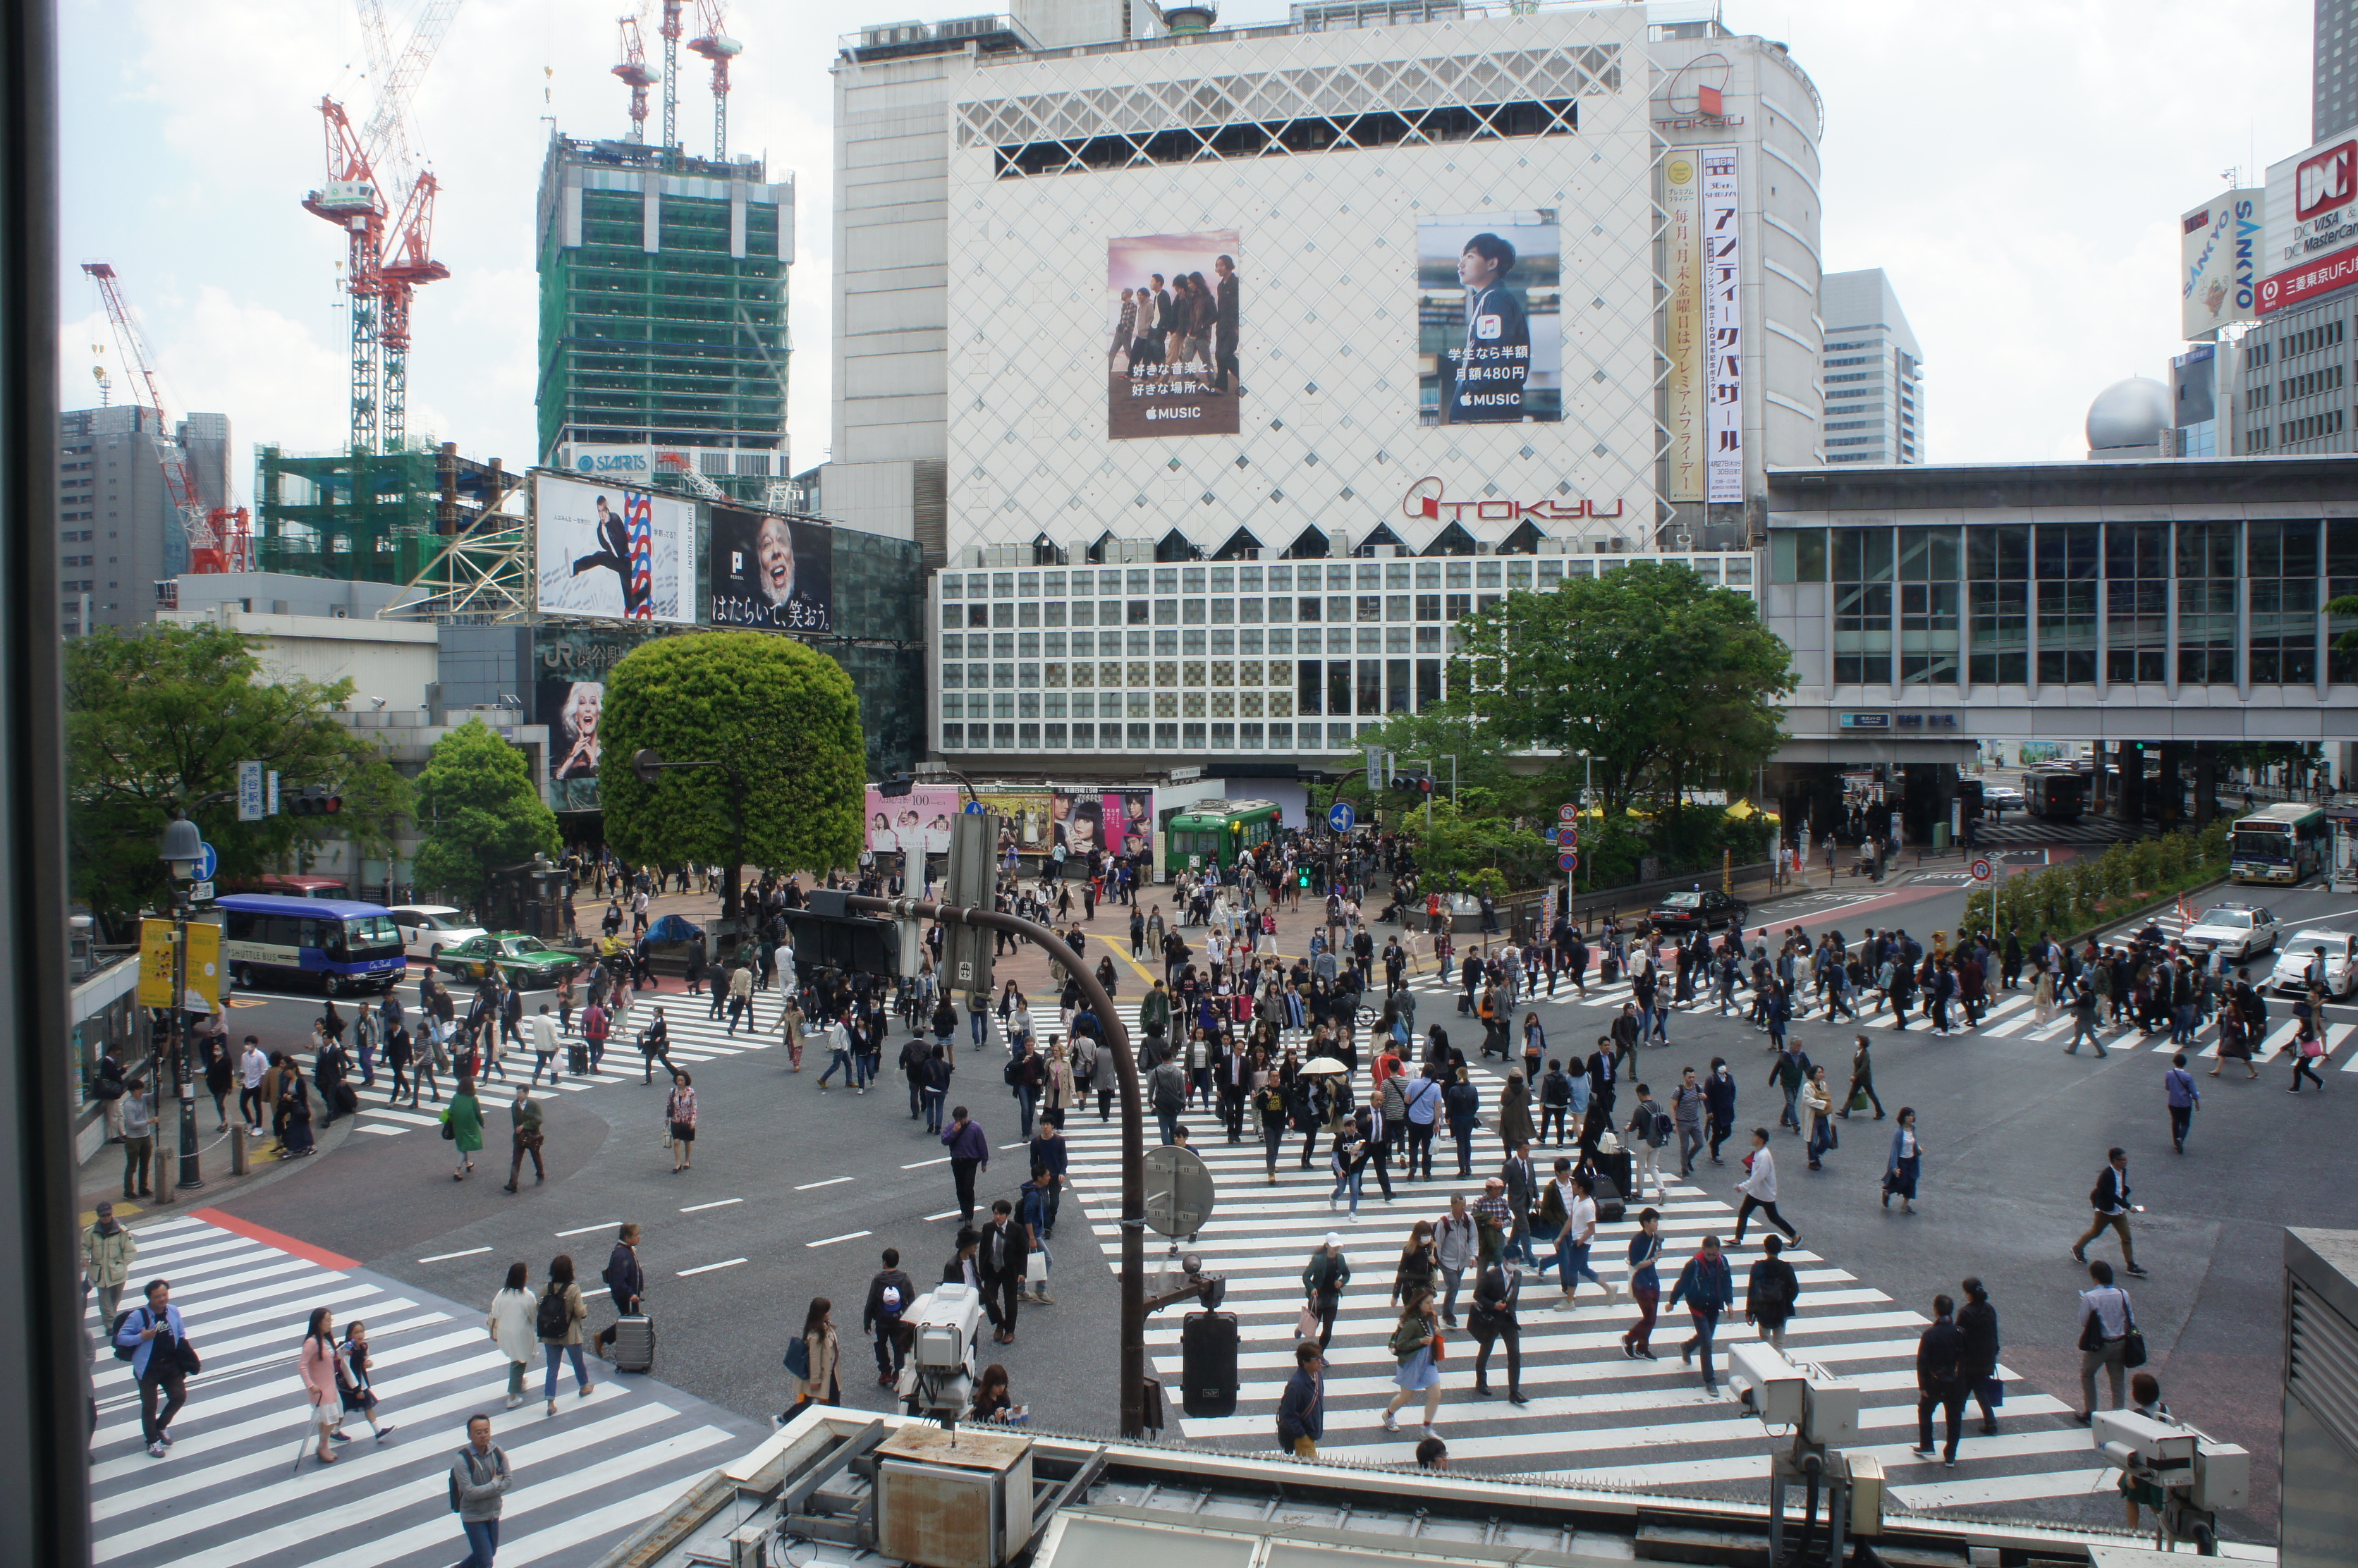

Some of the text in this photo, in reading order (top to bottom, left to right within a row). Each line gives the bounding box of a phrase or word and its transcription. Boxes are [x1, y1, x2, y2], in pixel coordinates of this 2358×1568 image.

[1656, 116, 1745, 130] TOKYU
[2299, 149, 2348, 213] DC
[2284, 220, 2358, 261] DC MasterCar
[2294, 219, 2311, 242] DC
[2314, 210, 2340, 233] VISA
[2183, 210, 2230, 300] SANKYO
[2235, 200, 2262, 310] SANKYO
[2286, 255, 2358, 295] 三菱東京UFJ
[1714, 208, 1740, 453] アンティークバザール
[1448, 345, 1534, 361] 学生なら半額。
[1675, 209, 1694, 489] 毎月、月末金曜日はプレミアムフライデー
[1133, 362, 1214, 377] 好きな音楽と、
[1455, 366, 1525, 381] 月額480円
[1132, 381, 1216, 396] 好きな場所へ。
[1474, 394, 1520, 406] MUSIC
[1159, 407, 1201, 419] MUSIC
[1441, 498, 1623, 520] TOKYU
[713, 595, 829, 630] はたらいて、笑おう。
[544, 642, 574, 669] JR
[248, 766, 259, 815] 渋谷駅前
[231, 948, 260, 961] SHUTTLE
[262, 952, 277, 962] BUS
